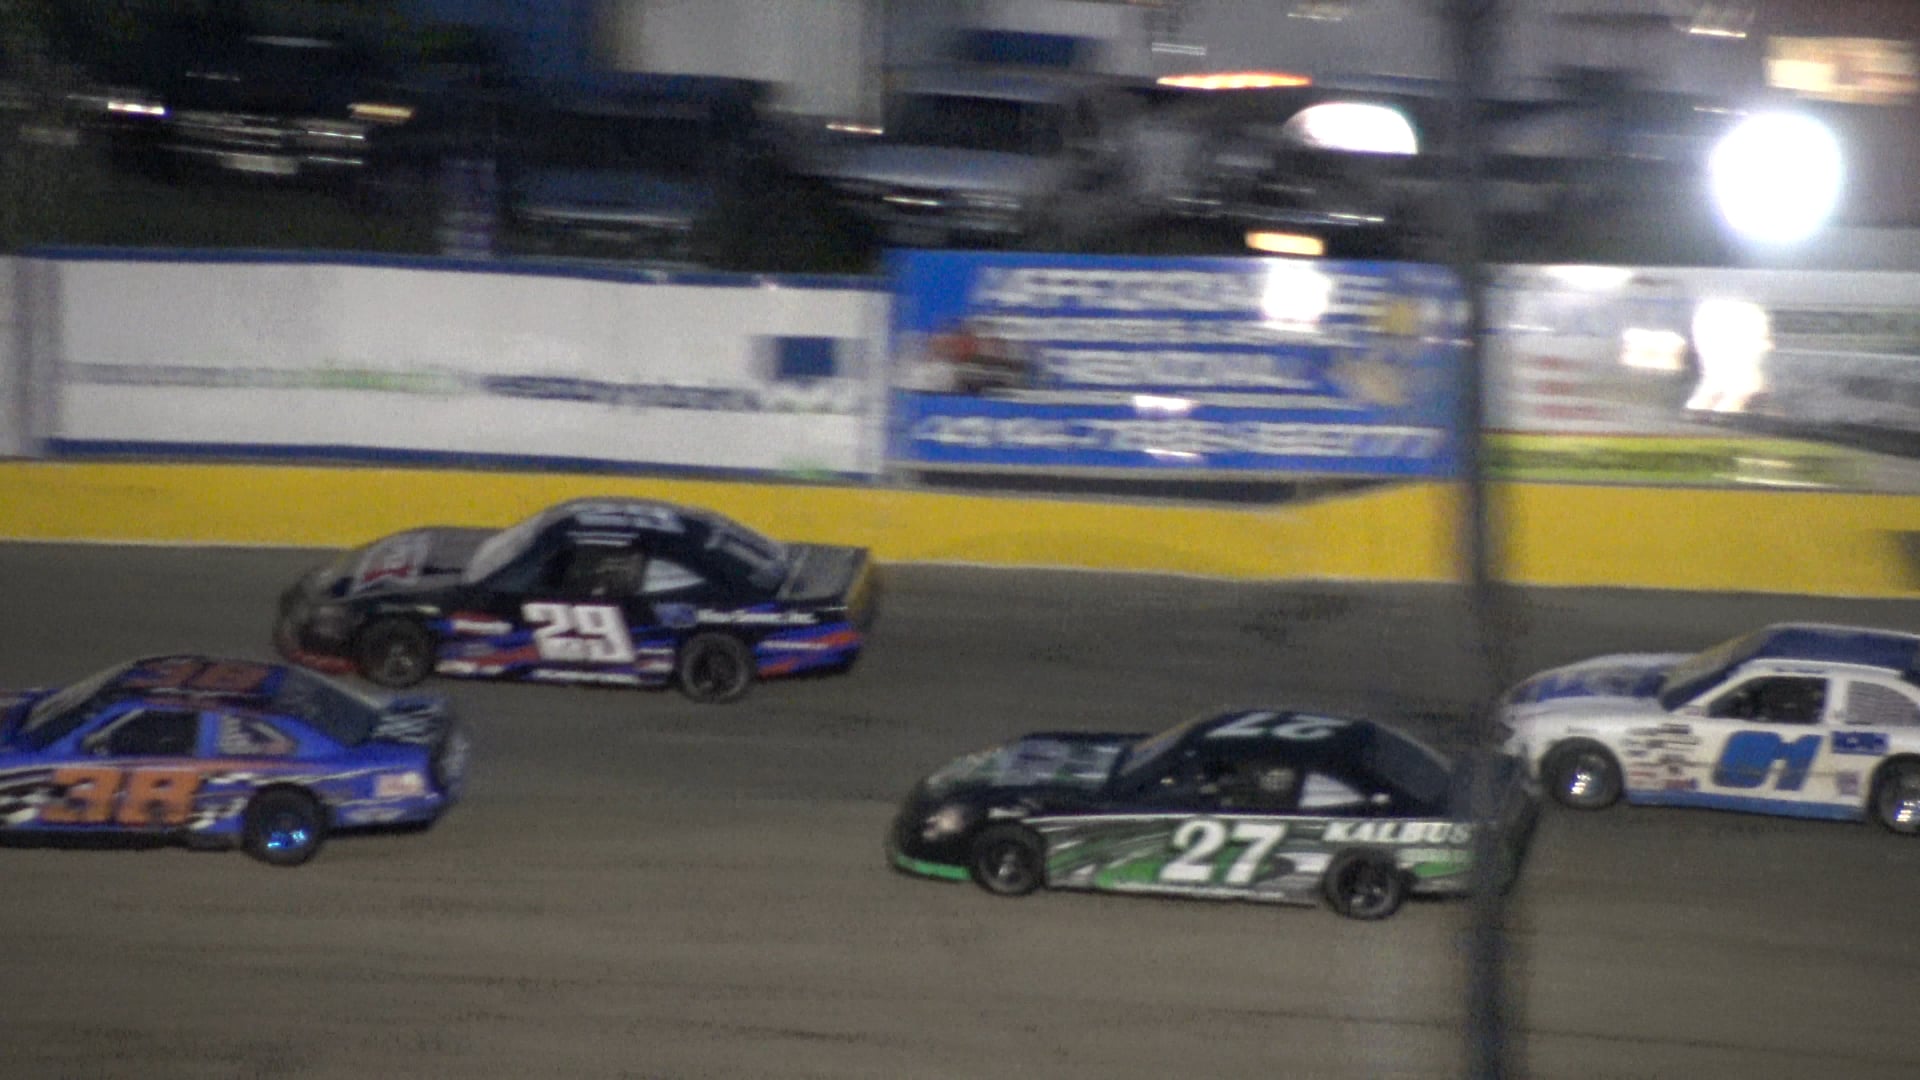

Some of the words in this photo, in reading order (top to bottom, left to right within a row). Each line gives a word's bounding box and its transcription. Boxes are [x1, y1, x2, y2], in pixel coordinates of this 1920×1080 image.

[521, 602, 635, 663] 29
[1160, 820, 1288, 885] 27
[1322, 821, 1471, 844] KALBUS
